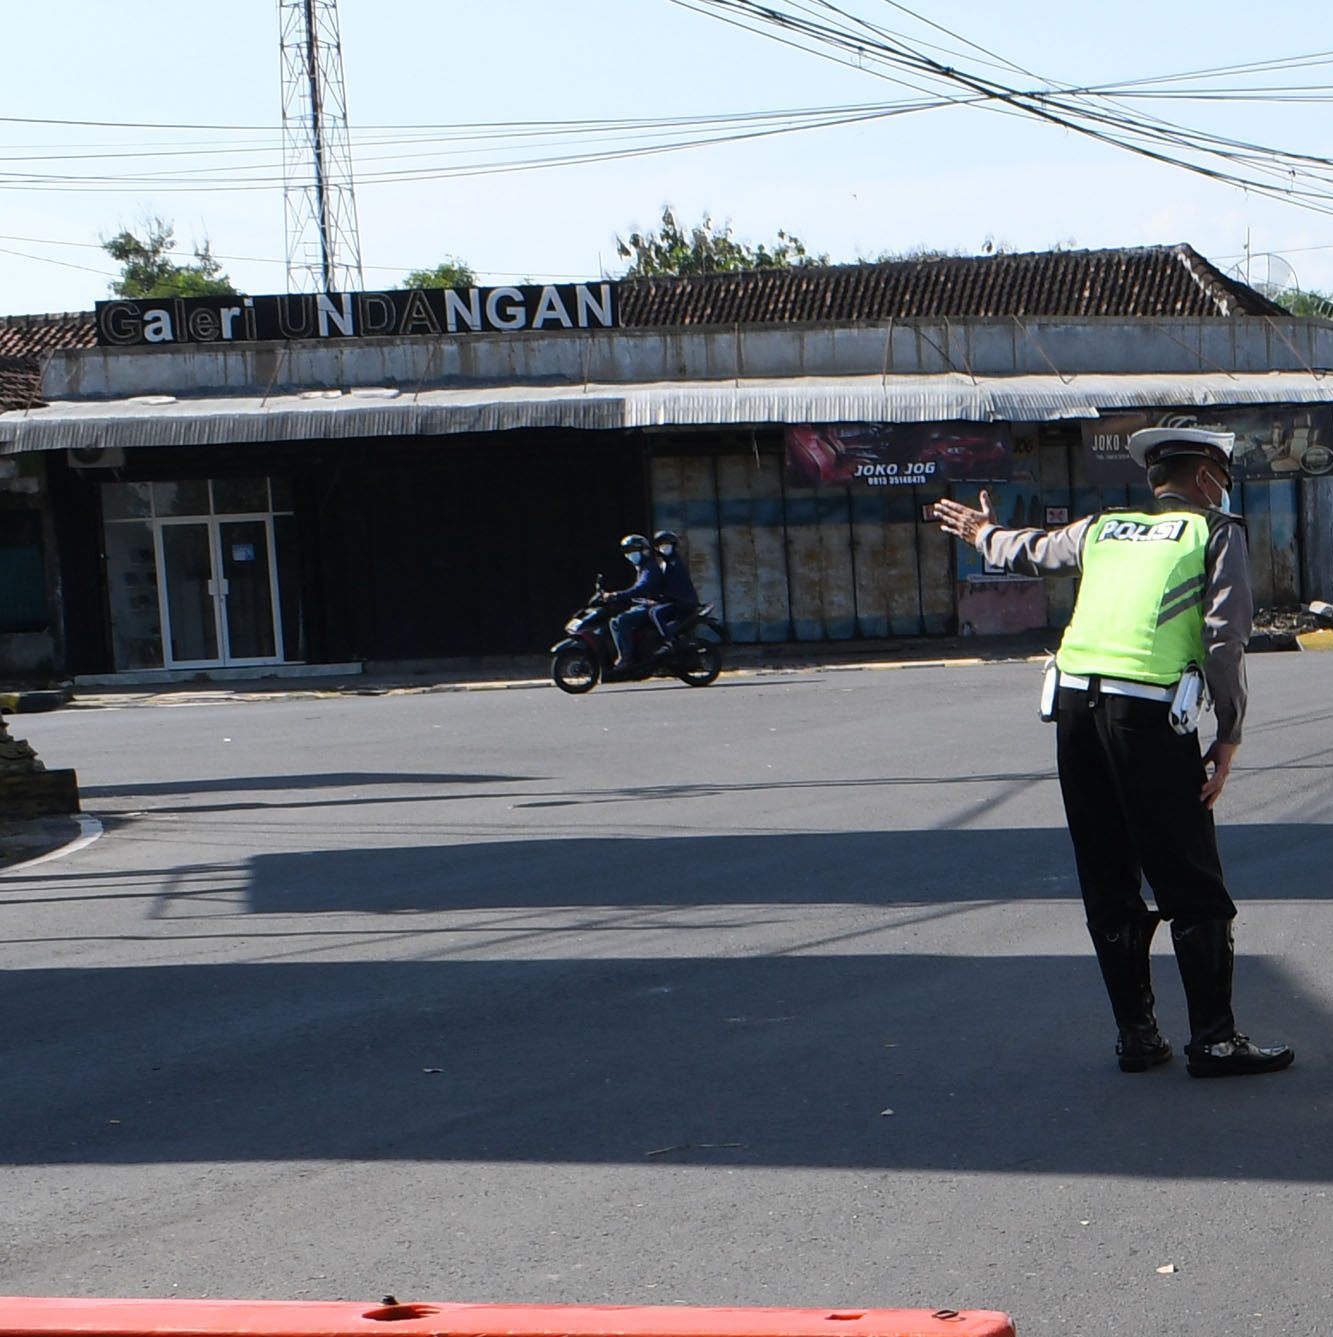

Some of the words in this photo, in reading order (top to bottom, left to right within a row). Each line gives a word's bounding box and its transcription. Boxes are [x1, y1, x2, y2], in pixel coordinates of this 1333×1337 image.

[100, 297, 258, 345] Galeri
[277, 284, 614, 339] UNDANGAN
[1091, 433, 1120, 451] JOKO
[854, 463, 898, 477] JOKO
[904, 461, 936, 475] JOG
[1098, 519, 1184, 542] POLISI
